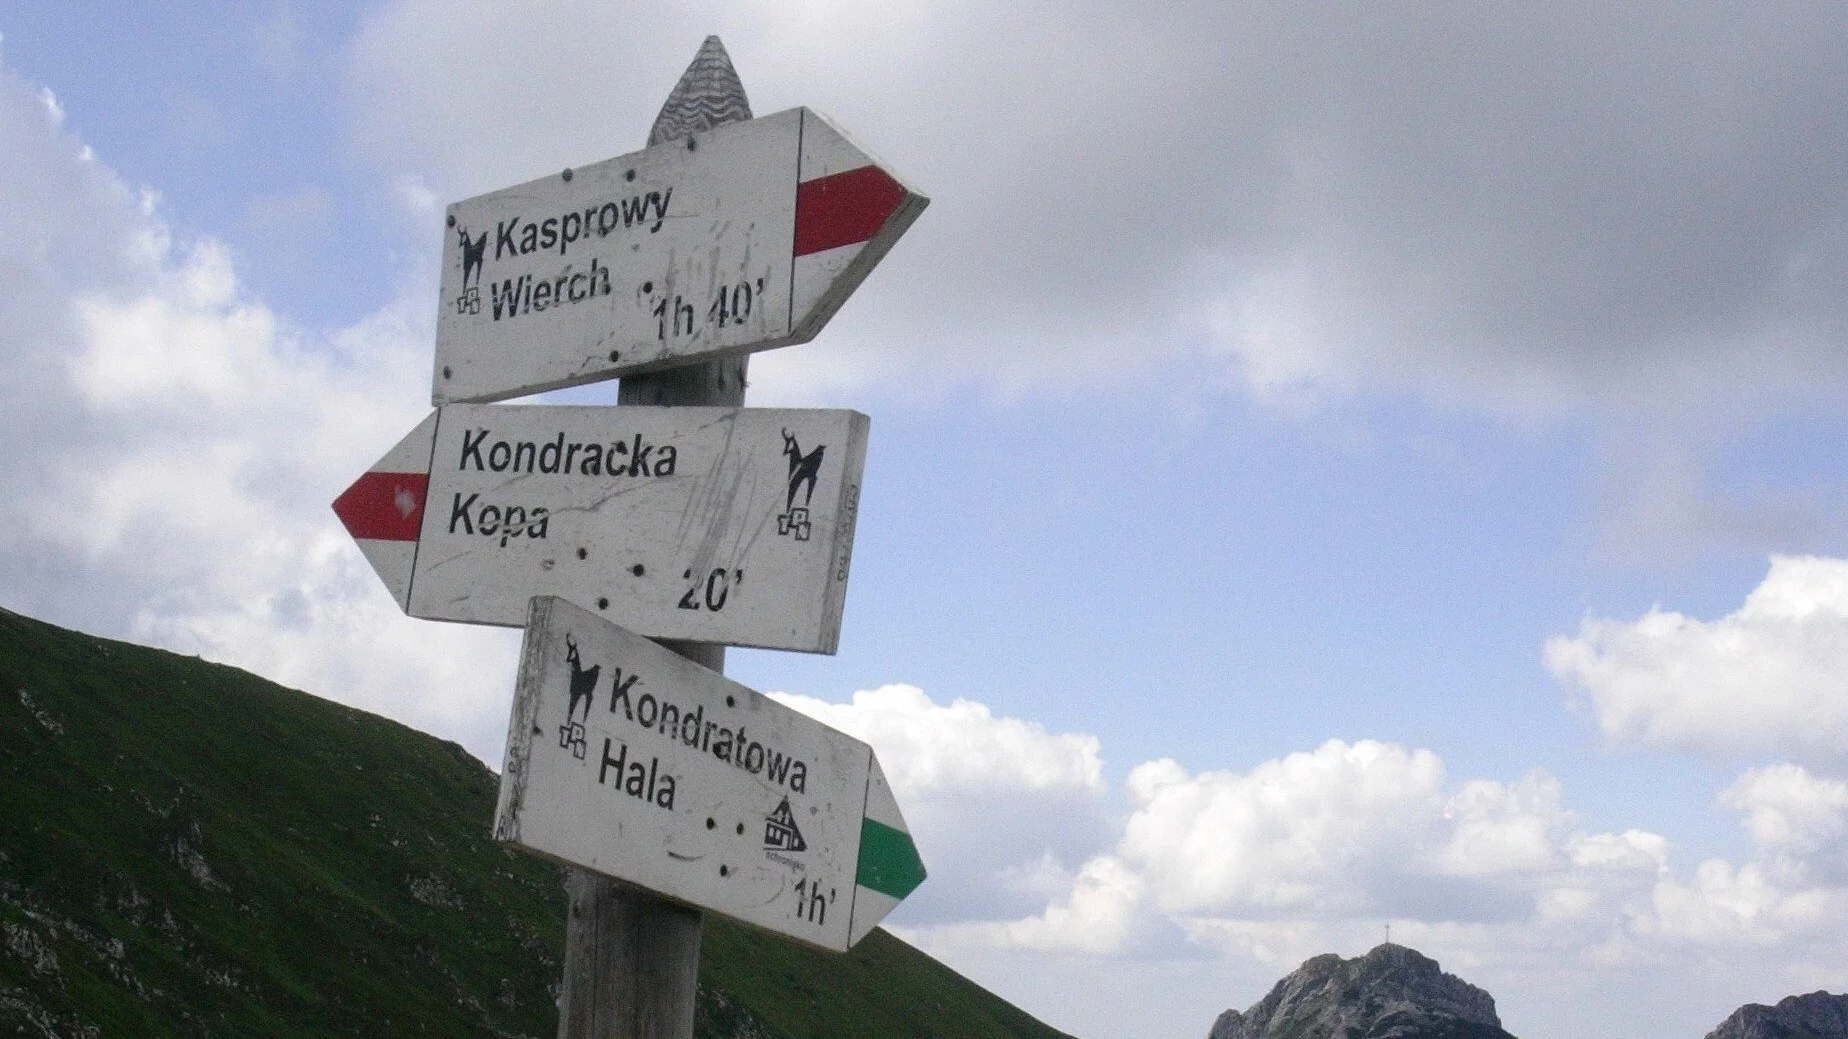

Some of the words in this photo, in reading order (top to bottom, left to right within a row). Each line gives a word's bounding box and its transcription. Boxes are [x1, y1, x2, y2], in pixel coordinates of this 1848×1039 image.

[495, 187, 673, 261] Kasprowy
[491, 257, 611, 322] Wierch
[653, 296, 694, 340] 1h
[707, 277, 764, 328] 40'
[459, 429, 678, 477] Kondracka
[449, 493, 549, 547] Kopa
[678, 568, 743, 612] 20'
[609, 667, 807, 795] Kondratowa
[600, 738, 677, 811] Hala
[795, 876, 836, 925] 1h'
